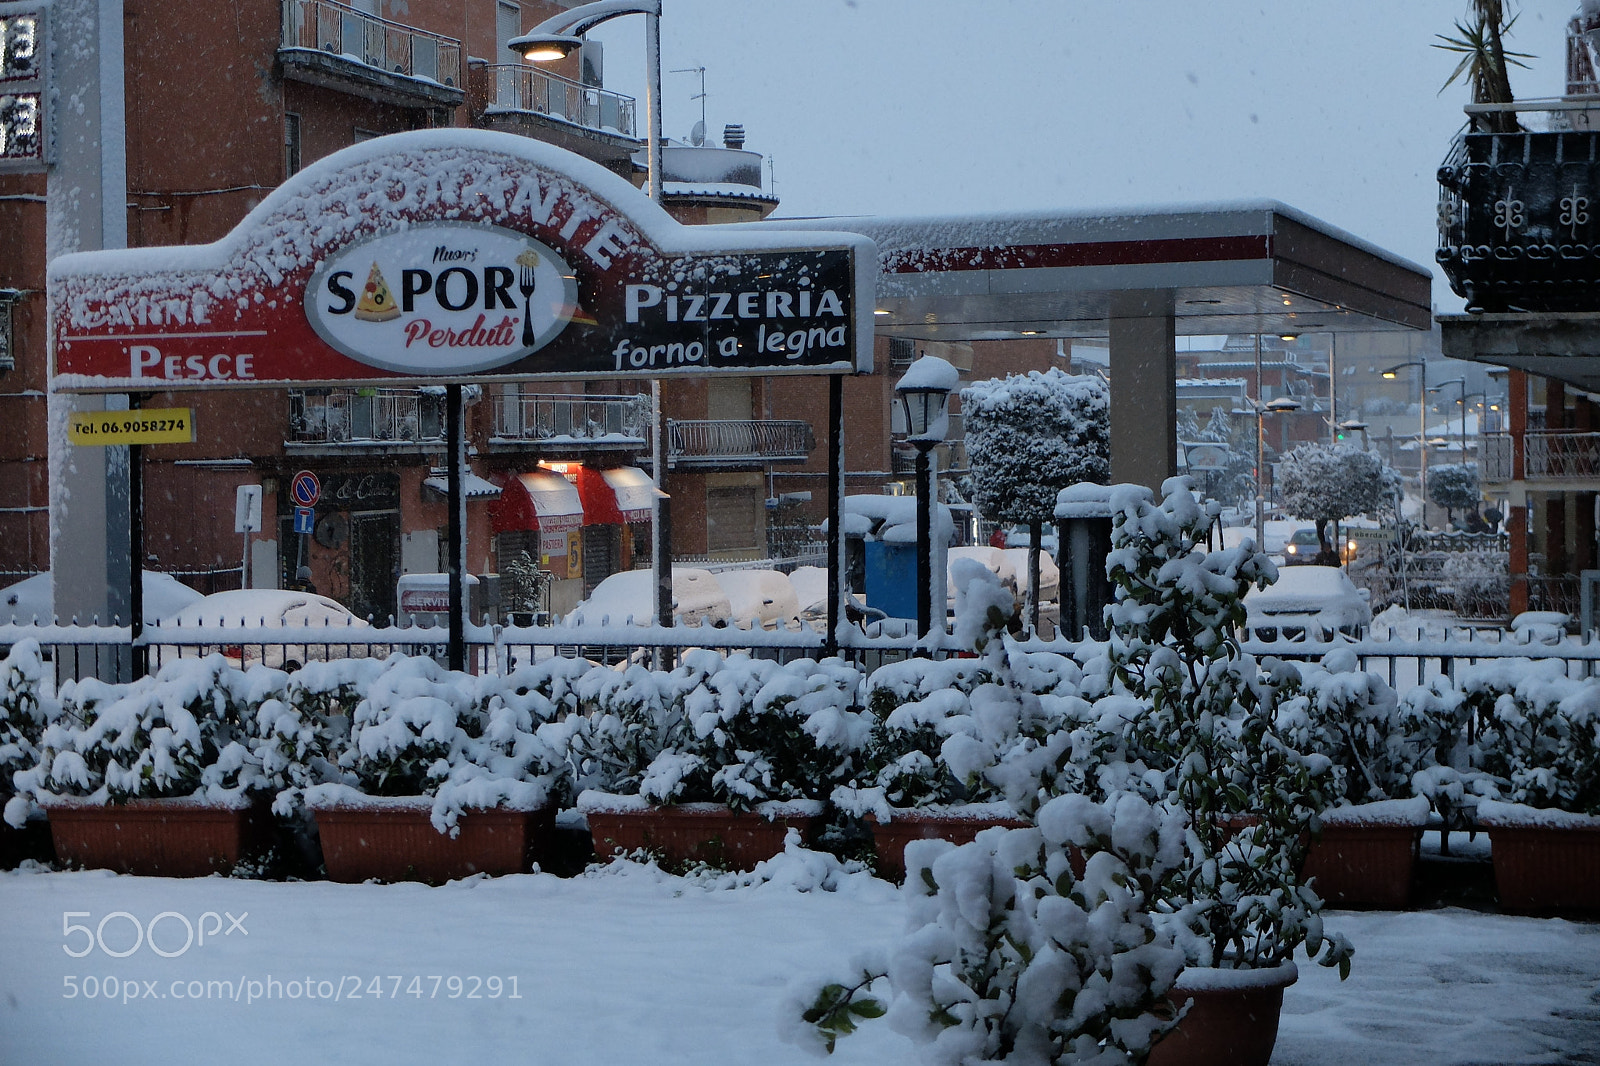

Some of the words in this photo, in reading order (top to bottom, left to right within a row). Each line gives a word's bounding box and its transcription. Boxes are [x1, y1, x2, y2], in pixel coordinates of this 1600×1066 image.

[247, 165, 636, 290] ORANTE
[70, 299, 211, 330] CARNE
[404, 313, 519, 349] Perduti
[612, 339, 704, 370] forno
[720, 336, 739, 357] a
[758, 325, 846, 360] legna
[74, 423, 98, 435] Tel.
[101, 420, 185, 434] 06.9058274
[570, 541, 578, 568] 5
[408, 596, 450, 607] SERVIT
